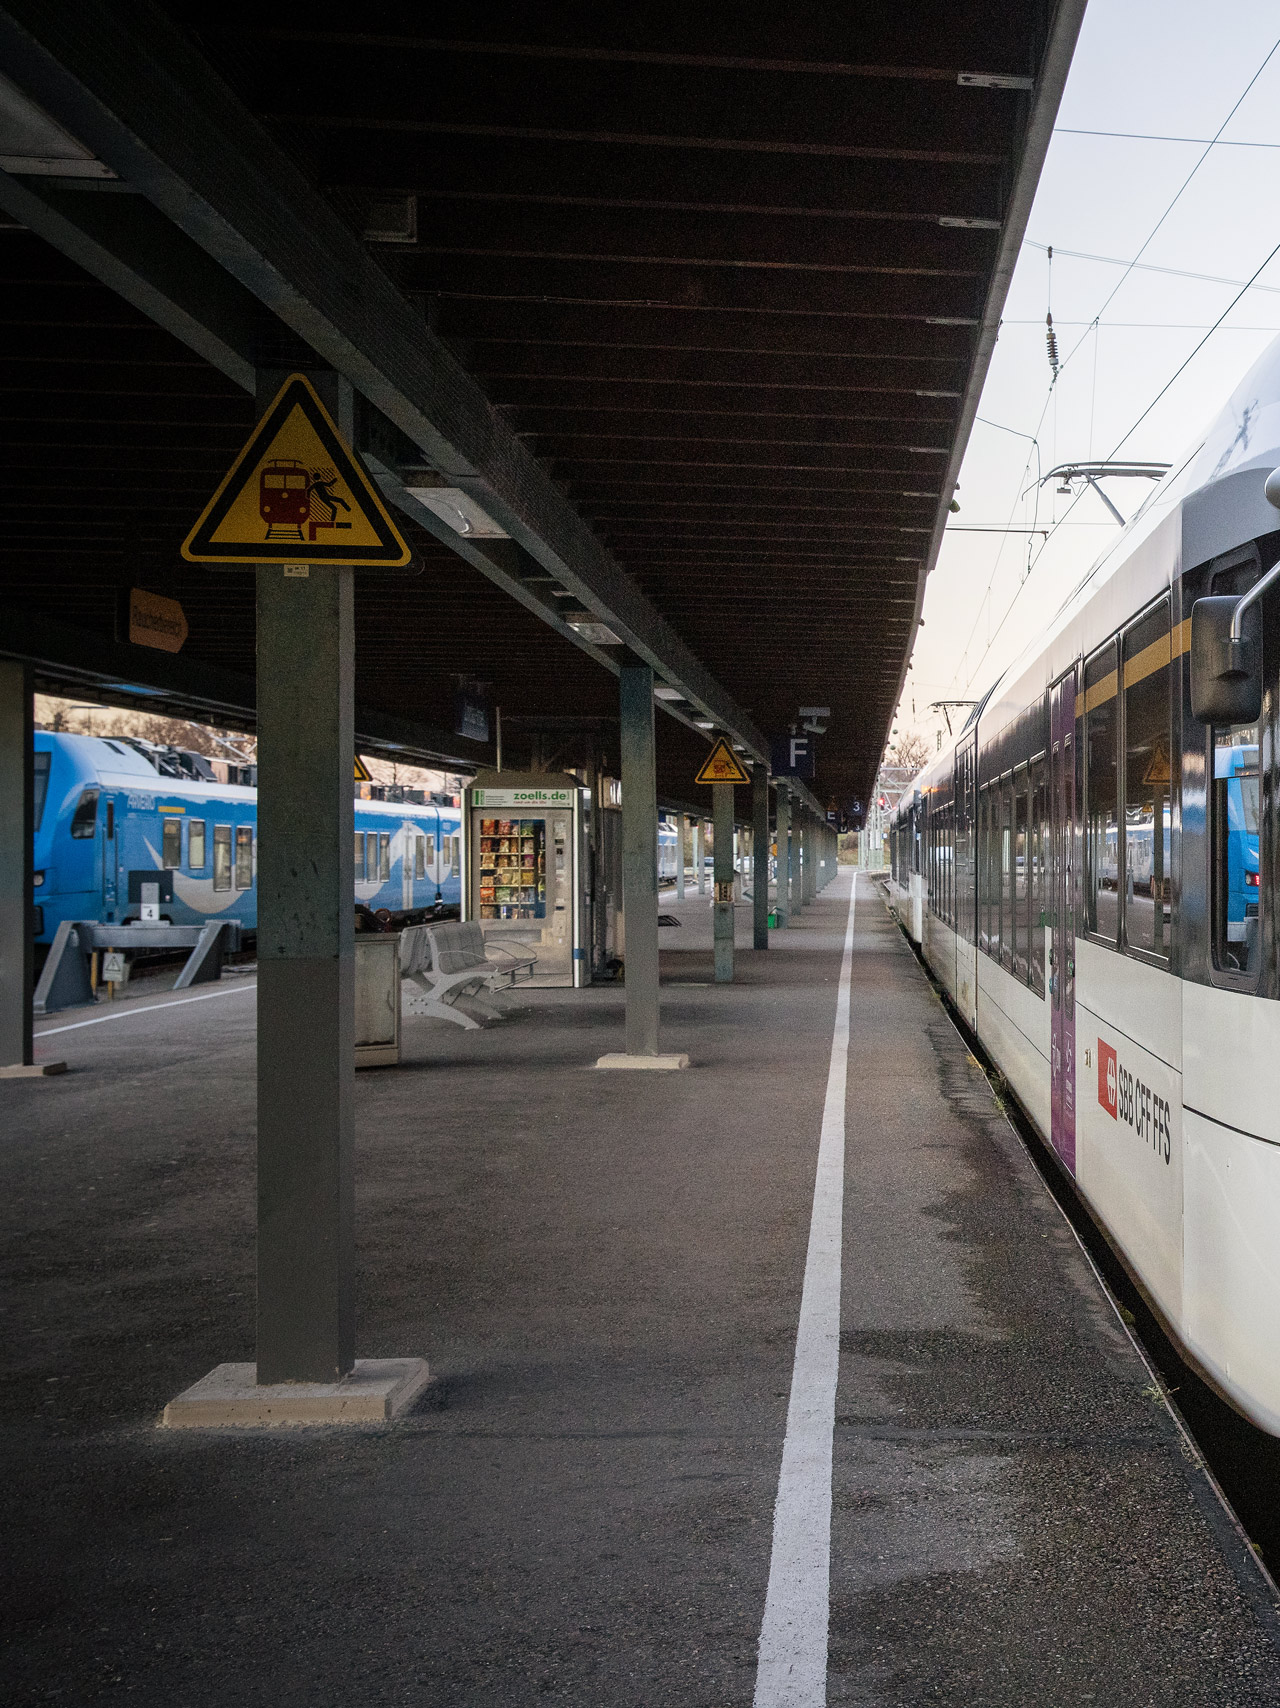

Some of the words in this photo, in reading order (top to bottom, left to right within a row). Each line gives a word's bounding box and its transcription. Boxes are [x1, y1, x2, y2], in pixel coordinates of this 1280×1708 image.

[790, 738, 808, 767] F
[513, 791, 566, 800] zoells.de
[853, 801, 860, 811] 3
[147, 909, 153, 918] 4
[1118, 1064, 1134, 1127] SBB
[1135, 1078, 1151, 1143] CFF
[1153, 1093, 1171, 1166] FFS
